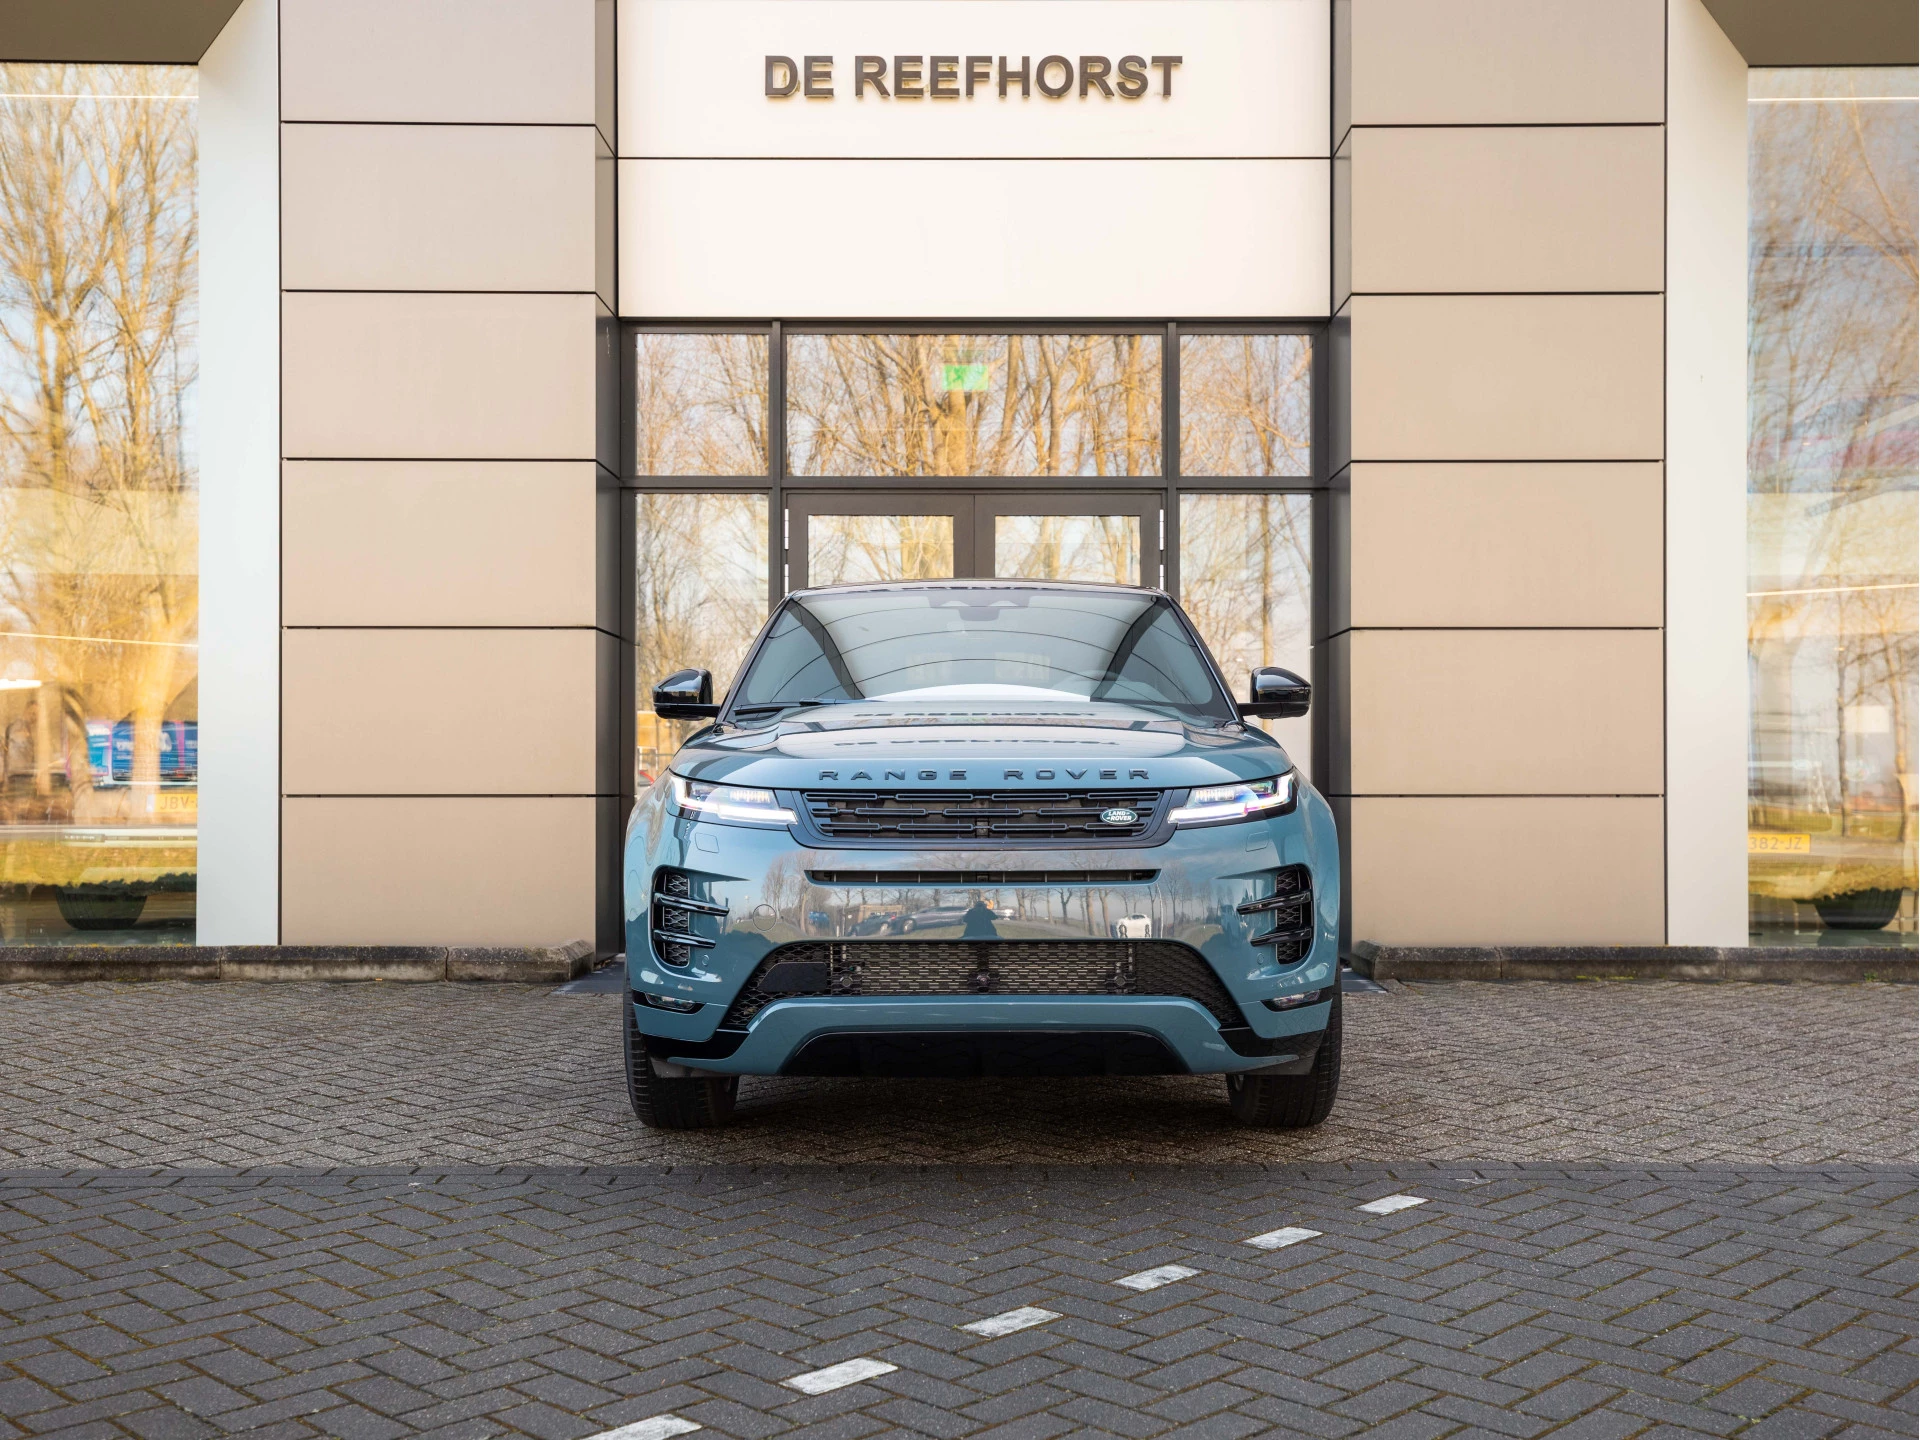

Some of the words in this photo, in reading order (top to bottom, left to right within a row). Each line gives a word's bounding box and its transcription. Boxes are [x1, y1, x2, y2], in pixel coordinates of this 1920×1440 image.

[764, 55, 835, 98] DE
[854, 54, 1183, 99] REEFHORST
[818, 768, 969, 781] RANGE
[1003, 768, 1151, 781] ROVER
